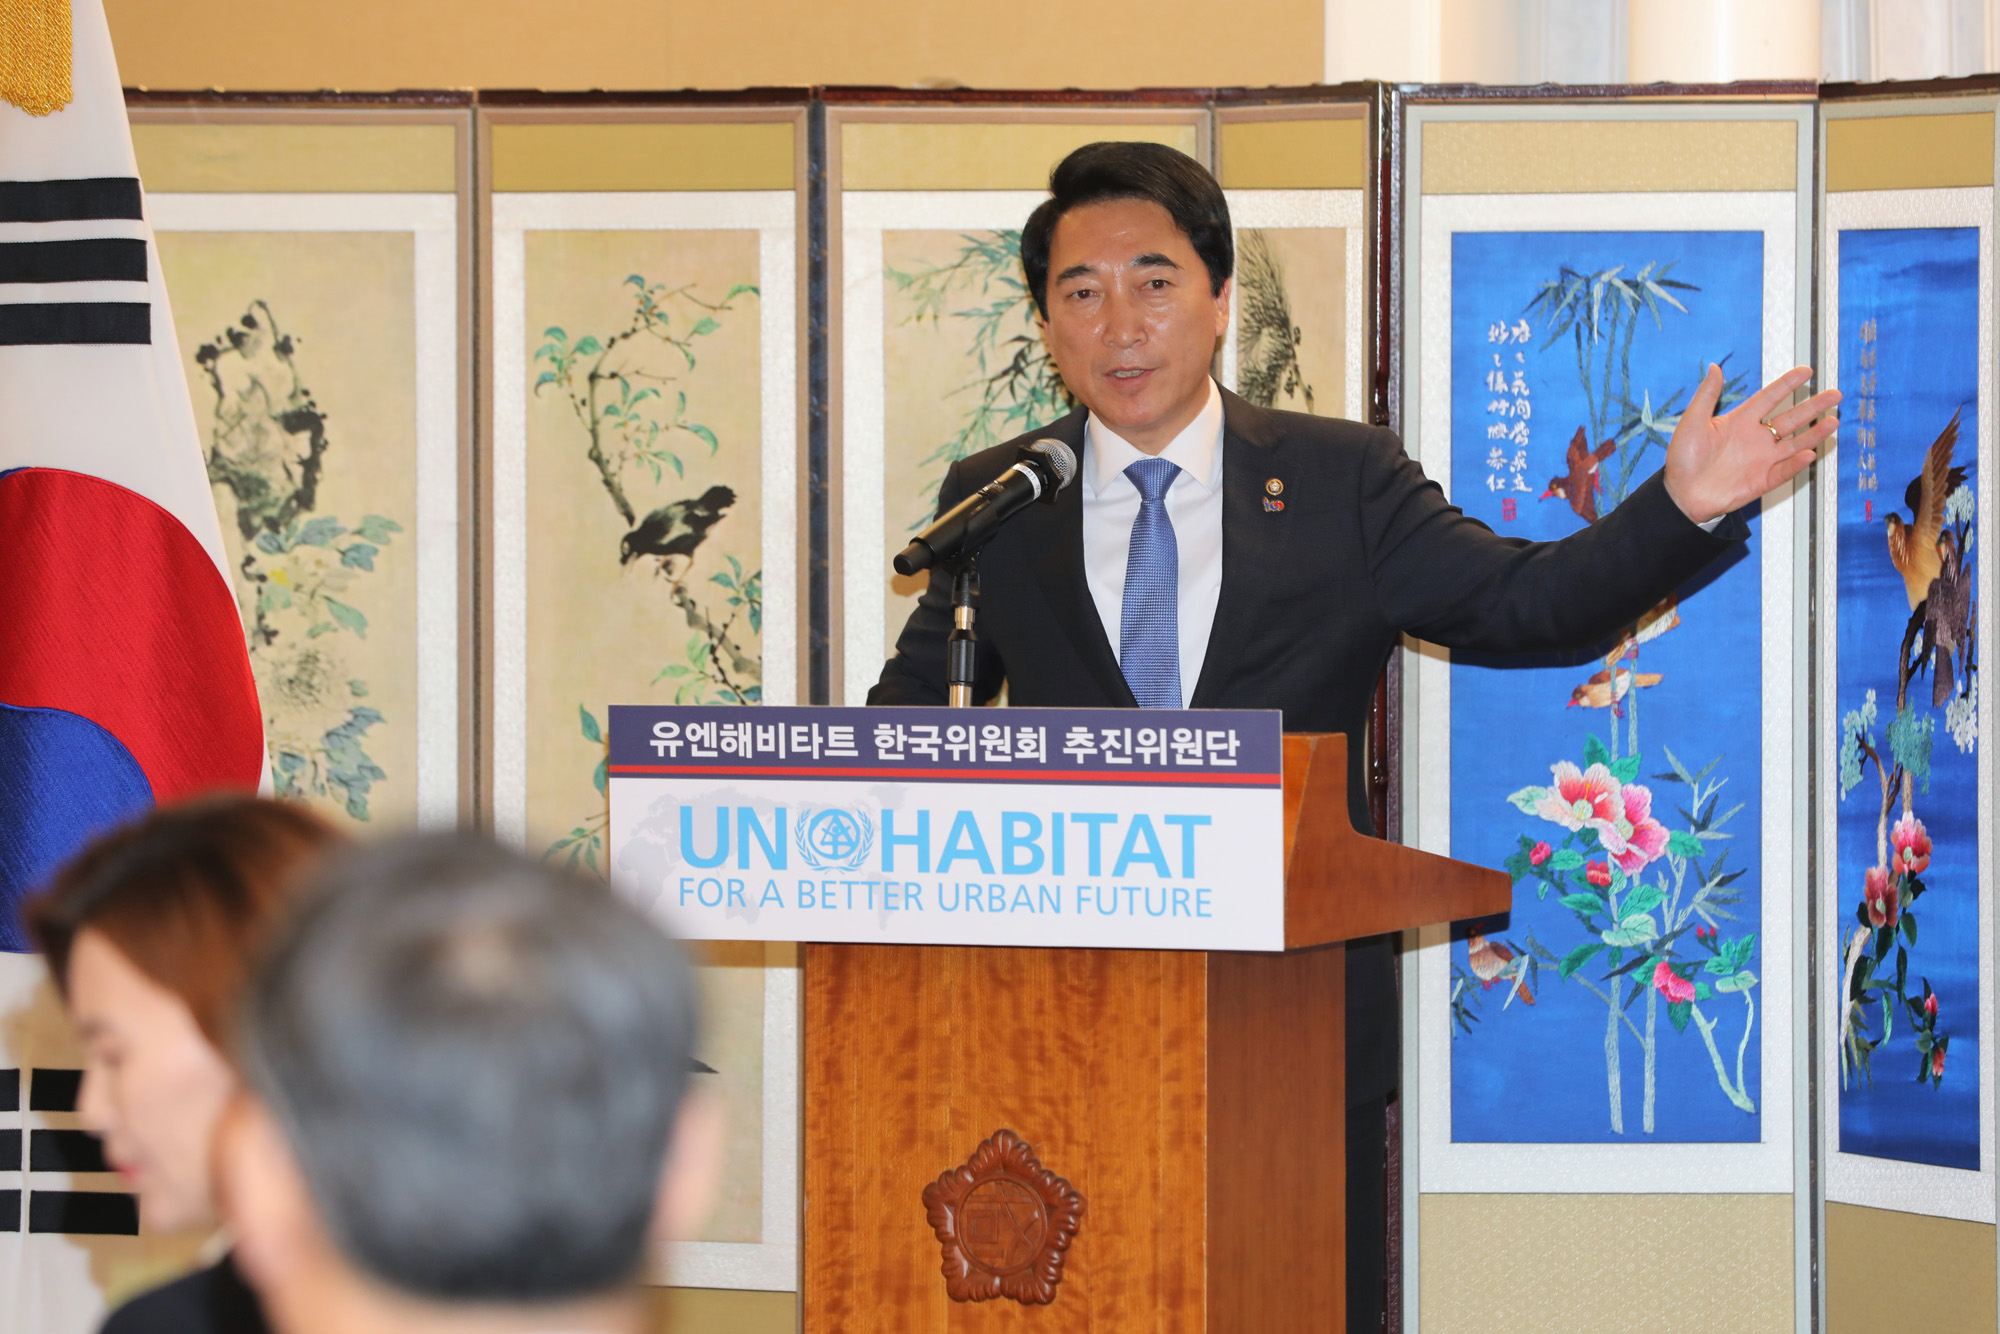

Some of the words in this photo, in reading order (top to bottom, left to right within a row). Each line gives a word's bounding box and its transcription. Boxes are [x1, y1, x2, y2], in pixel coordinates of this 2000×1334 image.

[650, 722, 858, 759] 유엔해비타트
[874, 724, 1046, 763] 한국위원회
[1063, 727, 1240, 766] 추진위원단
[680, 806, 787, 870] UN
[881, 809, 1212, 878] HABITAT
[680, 878, 746, 907] FOR
[760, 880, 784, 907] A
[799, 880, 923, 910] BETTER
[939, 883, 1060, 913] URBAN
[1077, 886, 1211, 917] FUTURE
